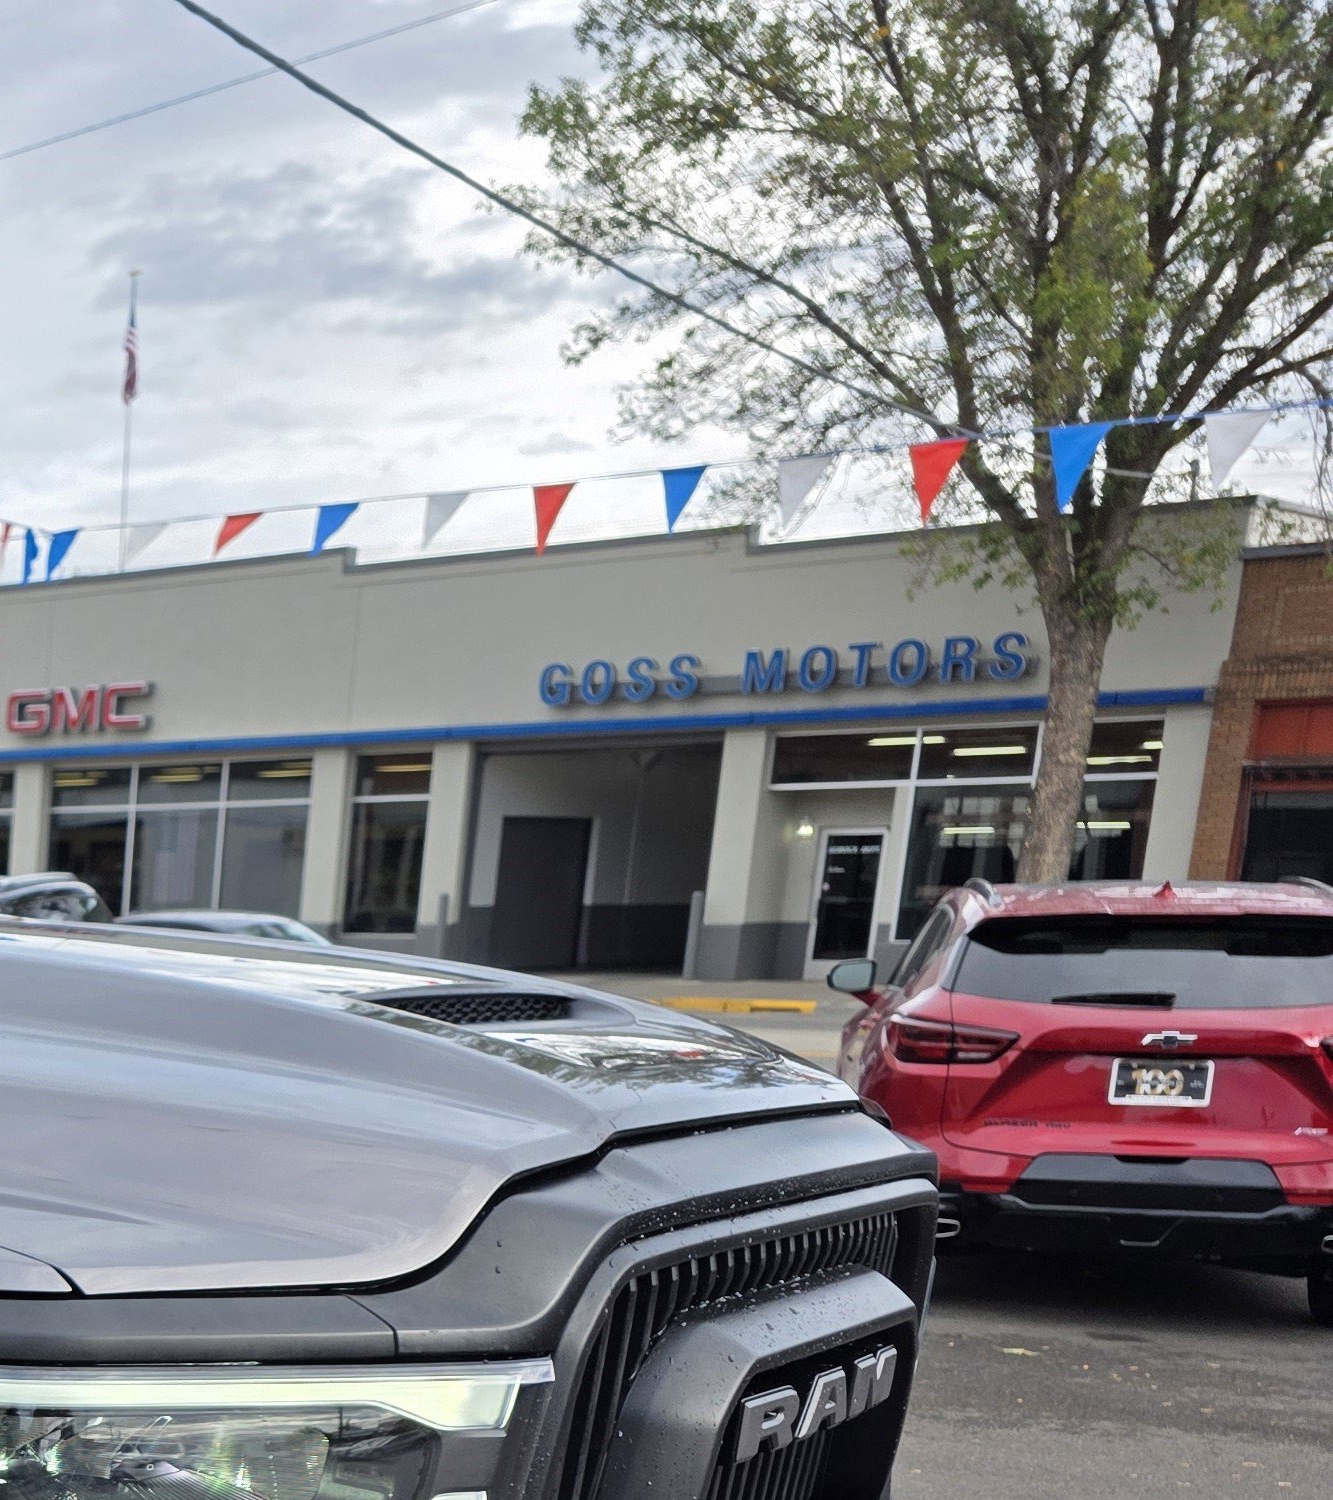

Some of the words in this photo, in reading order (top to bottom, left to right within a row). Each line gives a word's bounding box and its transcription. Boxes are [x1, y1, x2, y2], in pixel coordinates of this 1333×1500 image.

[538, 654, 701, 707] GOSS
[741, 631, 1031, 695] MOTORS
[6, 681, 155, 736] GMC
[1131, 1068, 1185, 1096] 100
[734, 1344, 899, 1465] RAM
